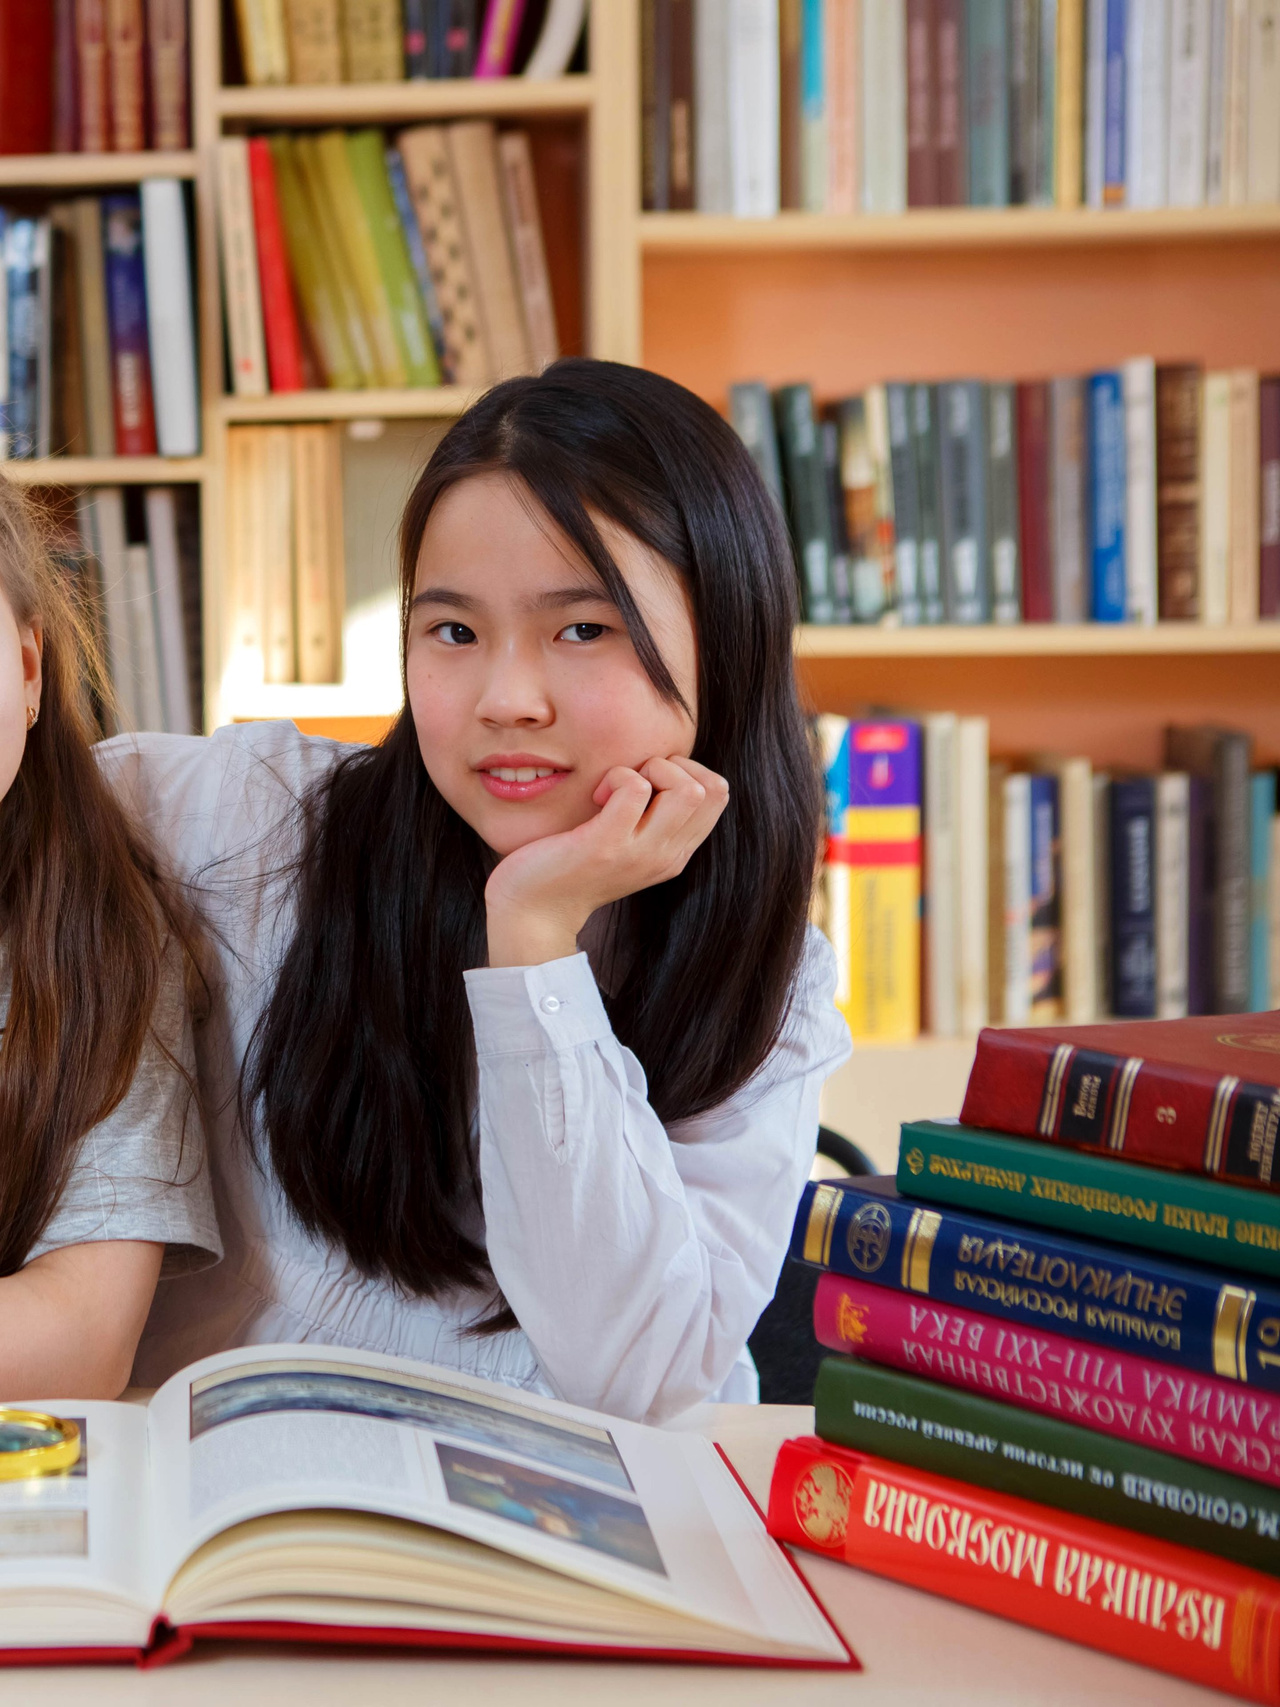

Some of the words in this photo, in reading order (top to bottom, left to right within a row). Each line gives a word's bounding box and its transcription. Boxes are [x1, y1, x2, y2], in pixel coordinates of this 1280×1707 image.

[1154, 1106, 1177, 1125] 3
[928, 1154, 1027, 1194] МОНАРХОВ
[1029, 1175, 1158, 1223] РОССИЙСКИХ
[1162, 1203, 1229, 1240] БРАКИ
[953, 1269, 1078, 1323] РОССИЙСКАЯ
[957, 1233, 1187, 1321] ЭНЦИКЛОПЕДИЯ
[908, 1304, 984, 1352] ВЕКА
[1084, 1304, 1181, 1351] БОЛЬШАЯ
[901, 1337, 1177, 1446] ХУДОЖЕСТВЕННАЯ
[852, 1399, 918, 1434] РОССИИ
[920, 1417, 998, 1456] ДРЕВНЕЙ
[1001, 1440, 1084, 1482] ИСТОРИИ
[1087, 1464, 1115, 1490] ОБ
[862, 1477, 1050, 1589] МОСКОВИЯ
[1053, 1542, 1225, 1651] ВЕЛИКАЯ
